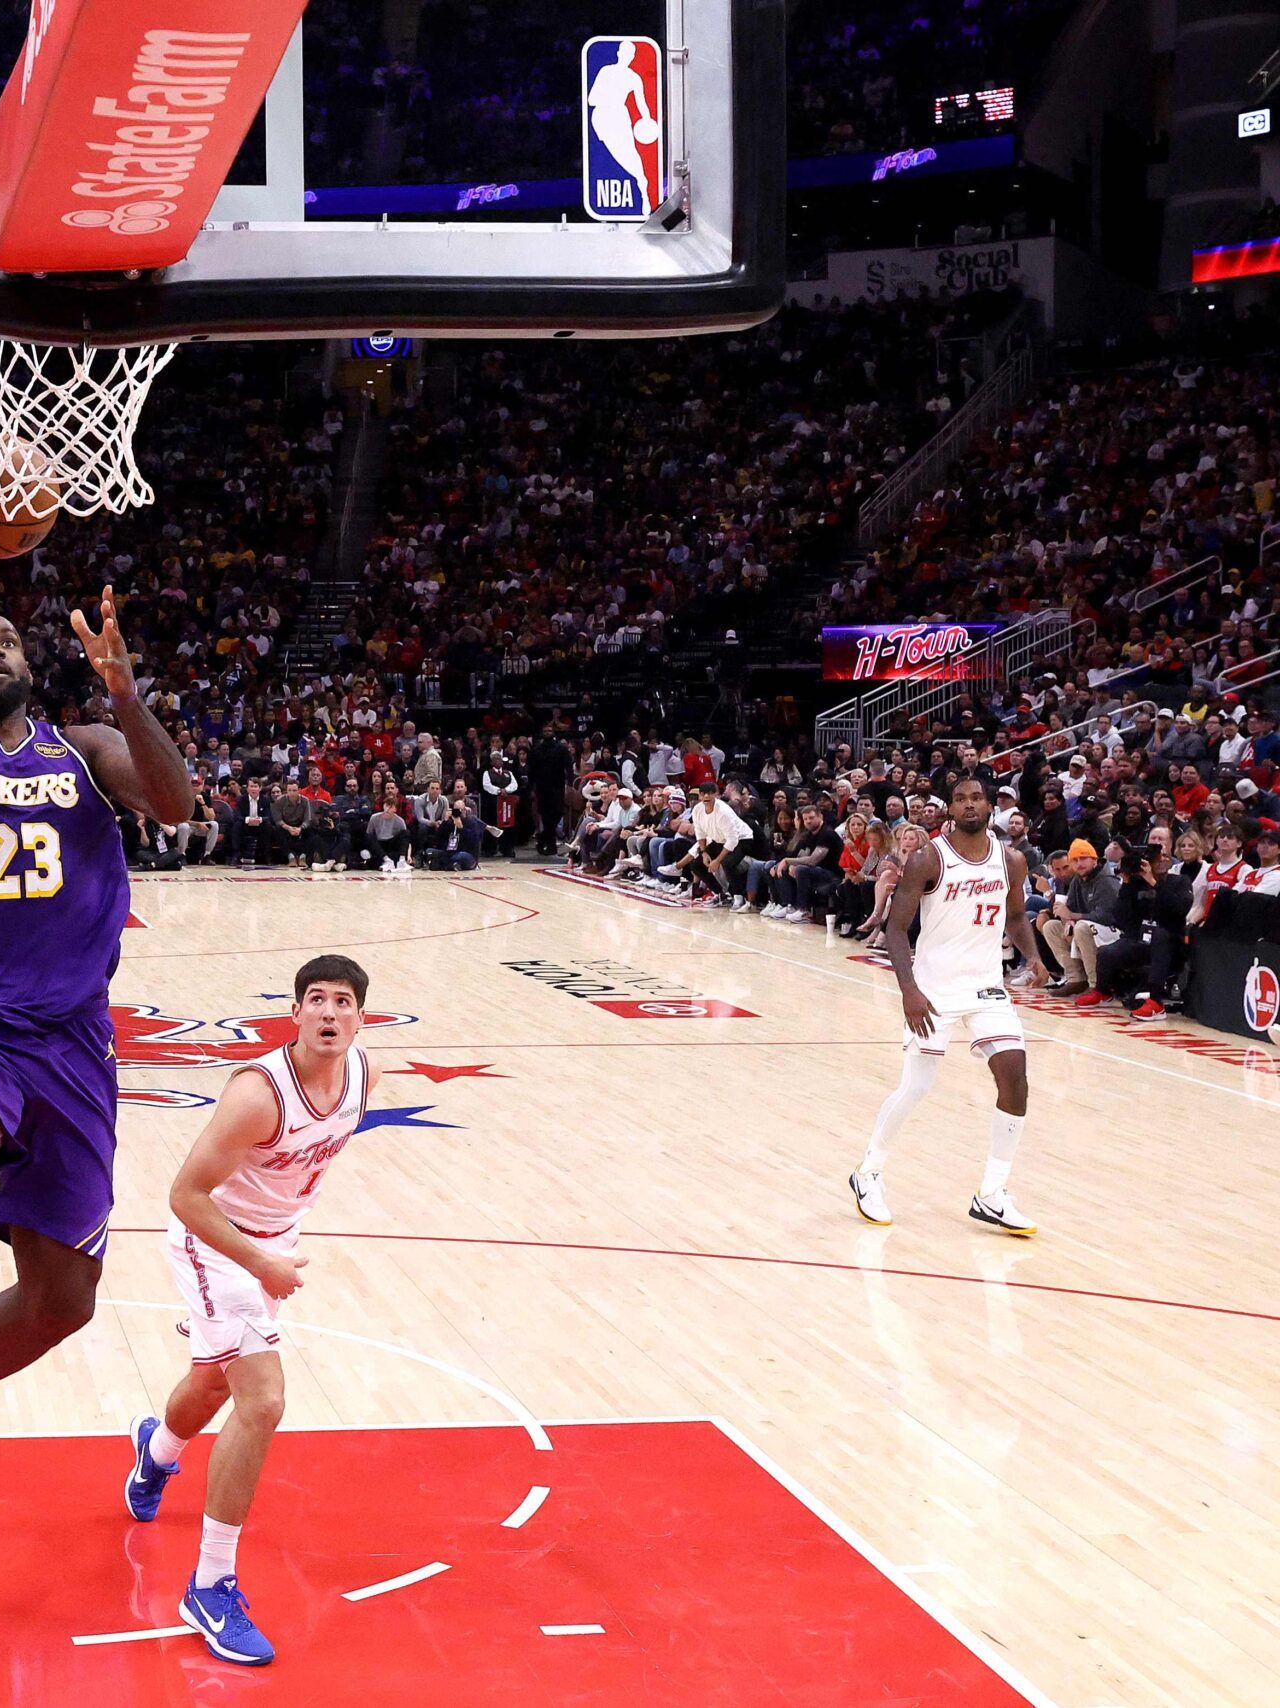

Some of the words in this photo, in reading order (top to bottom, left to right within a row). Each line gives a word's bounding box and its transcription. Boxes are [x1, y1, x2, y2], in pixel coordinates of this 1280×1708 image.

[596, 179, 633, 208] NBA
[936, 243, 1020, 274] Social
[947, 267, 1010, 291] Club
[852, 625, 973, 680] H-Town
[943, 877, 1004, 902] H-Town
[972, 904, 1001, 927] 17
[296, 1168, 324, 1199] 1
